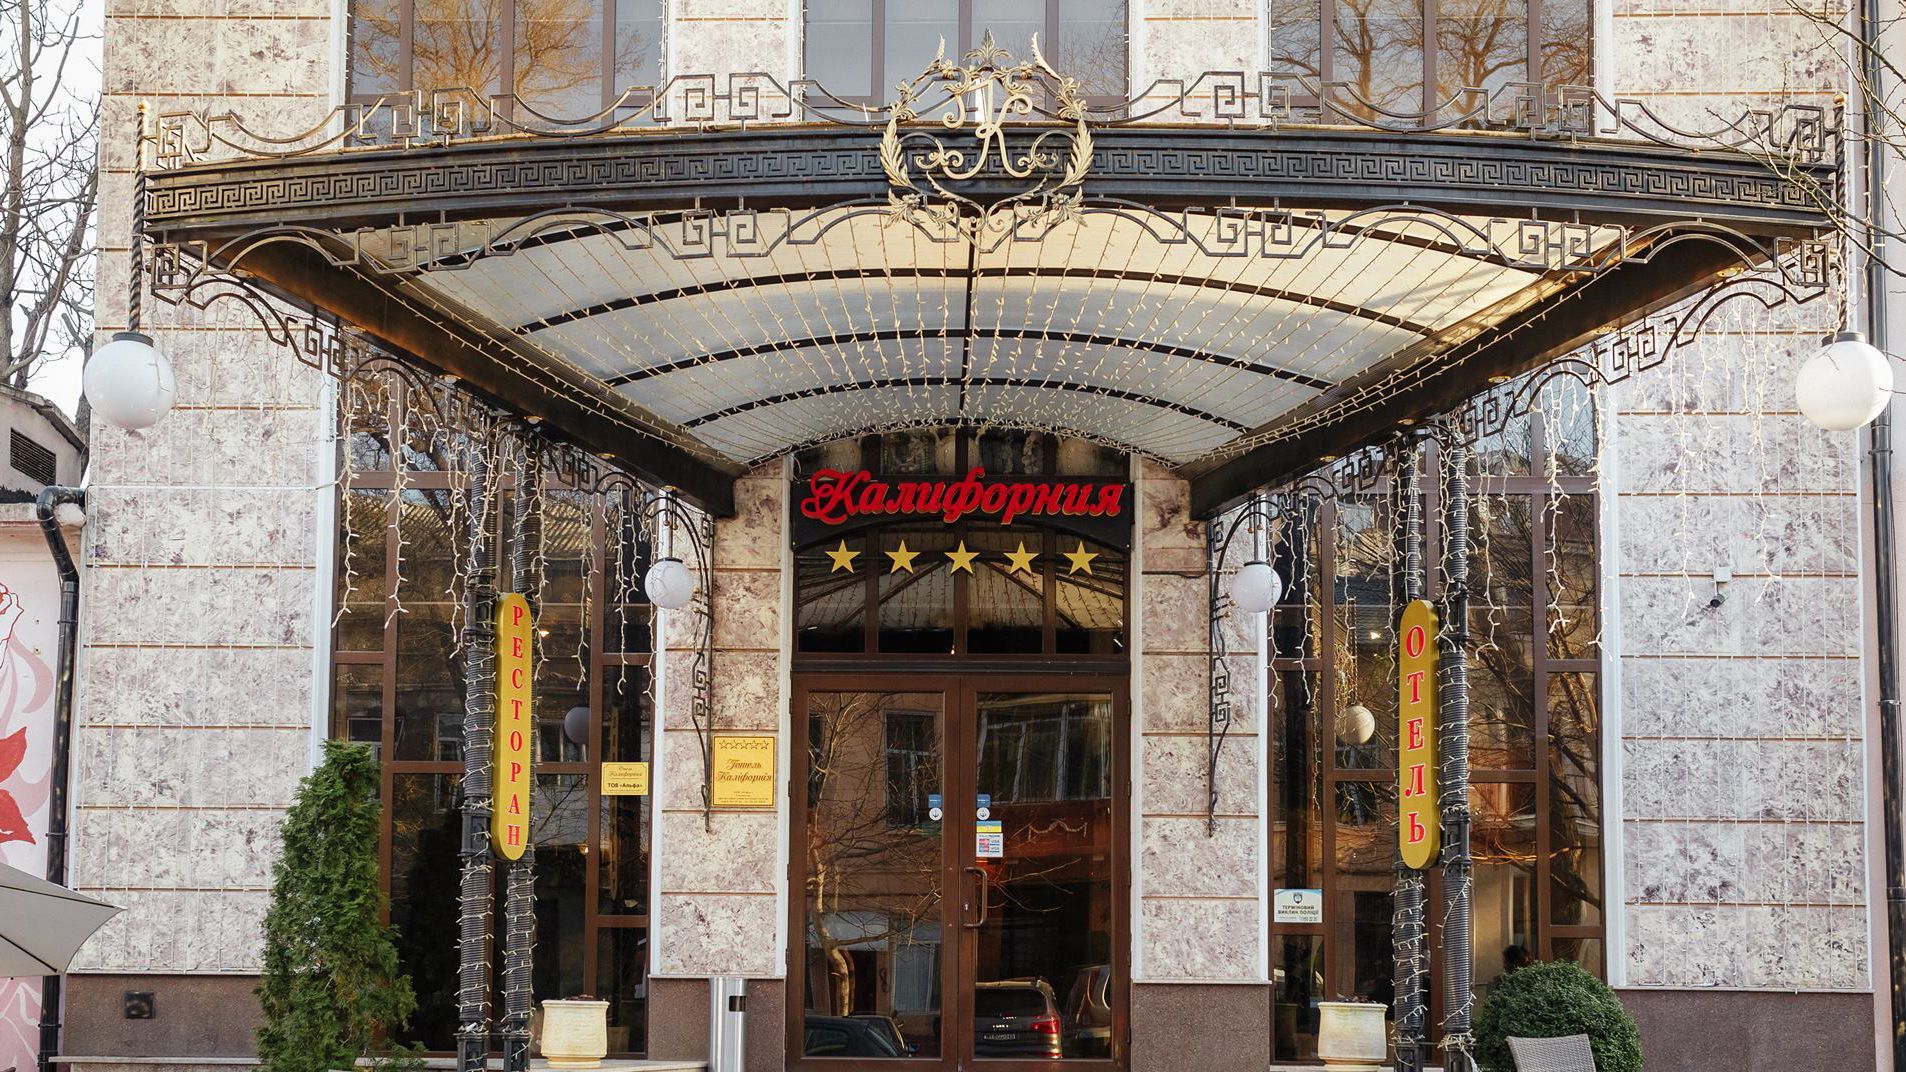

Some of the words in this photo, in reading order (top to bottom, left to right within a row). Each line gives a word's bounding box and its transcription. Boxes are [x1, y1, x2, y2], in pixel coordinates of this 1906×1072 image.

[800, 466, 1124, 525] Калифорния
[506, 604, 524, 847] РЕСТОРАН
[1404, 625, 1426, 844] ОТЕЛЬ
